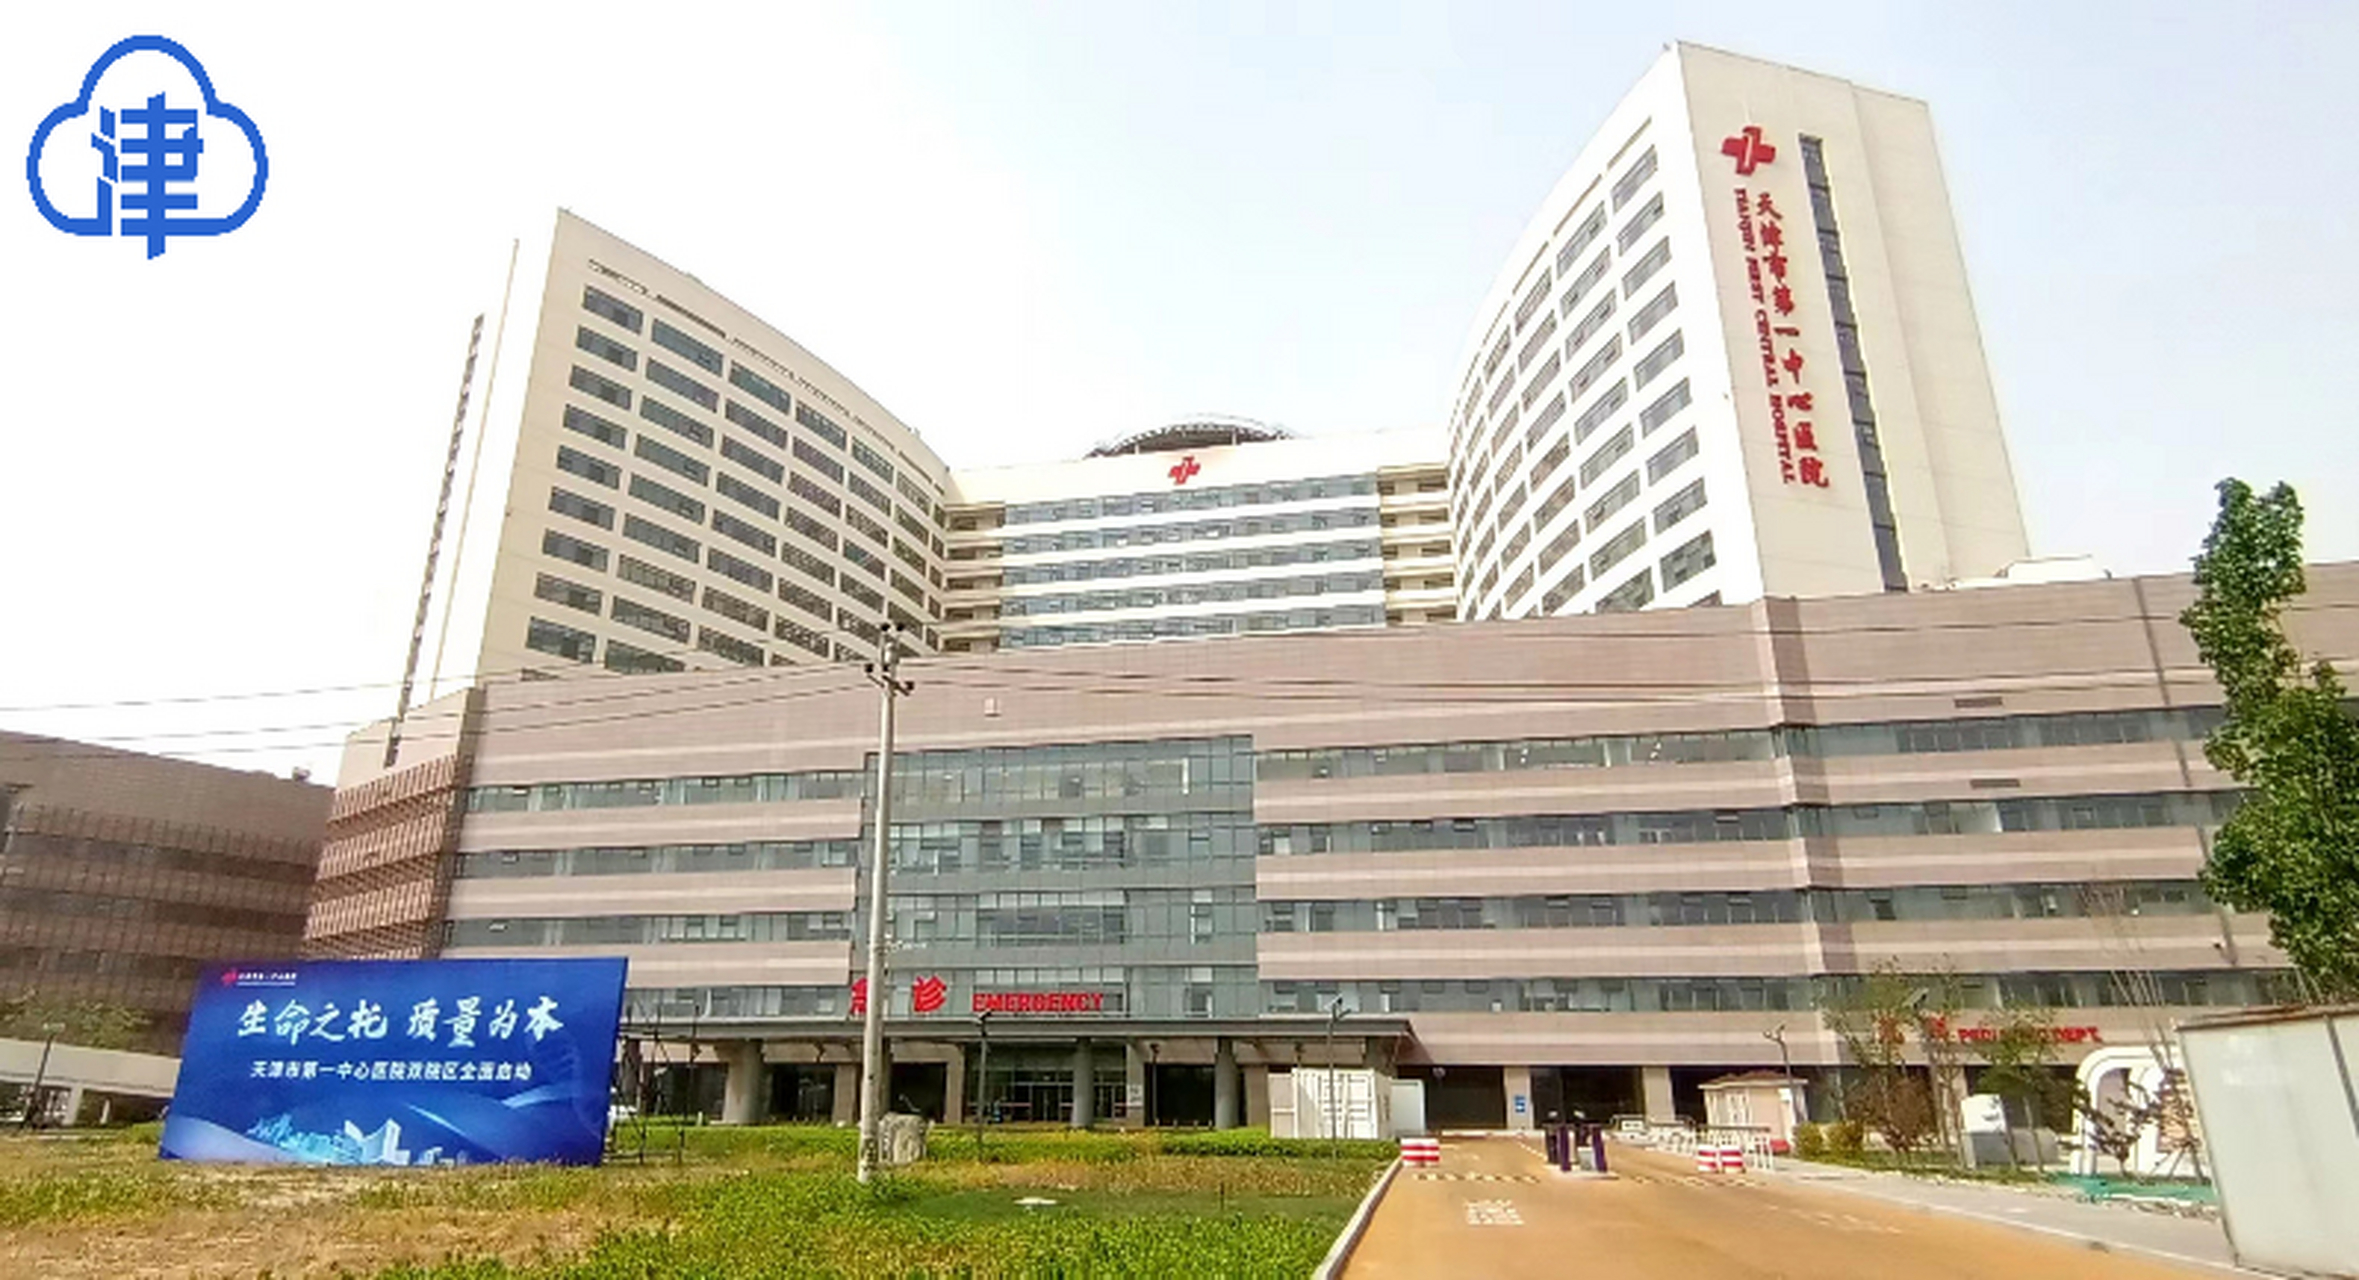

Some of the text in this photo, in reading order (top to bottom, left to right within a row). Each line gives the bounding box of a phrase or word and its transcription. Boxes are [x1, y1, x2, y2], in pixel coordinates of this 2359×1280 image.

[1745, 256, 1765, 304] FIRST
[1754, 308, 1779, 387] CENTRAL
[1768, 392, 1796, 485] HOSPITAL
[238, 995, 564, 1048] 生命之托 质量为本
[972, 992, 1103, 1012] EMERGENCY
